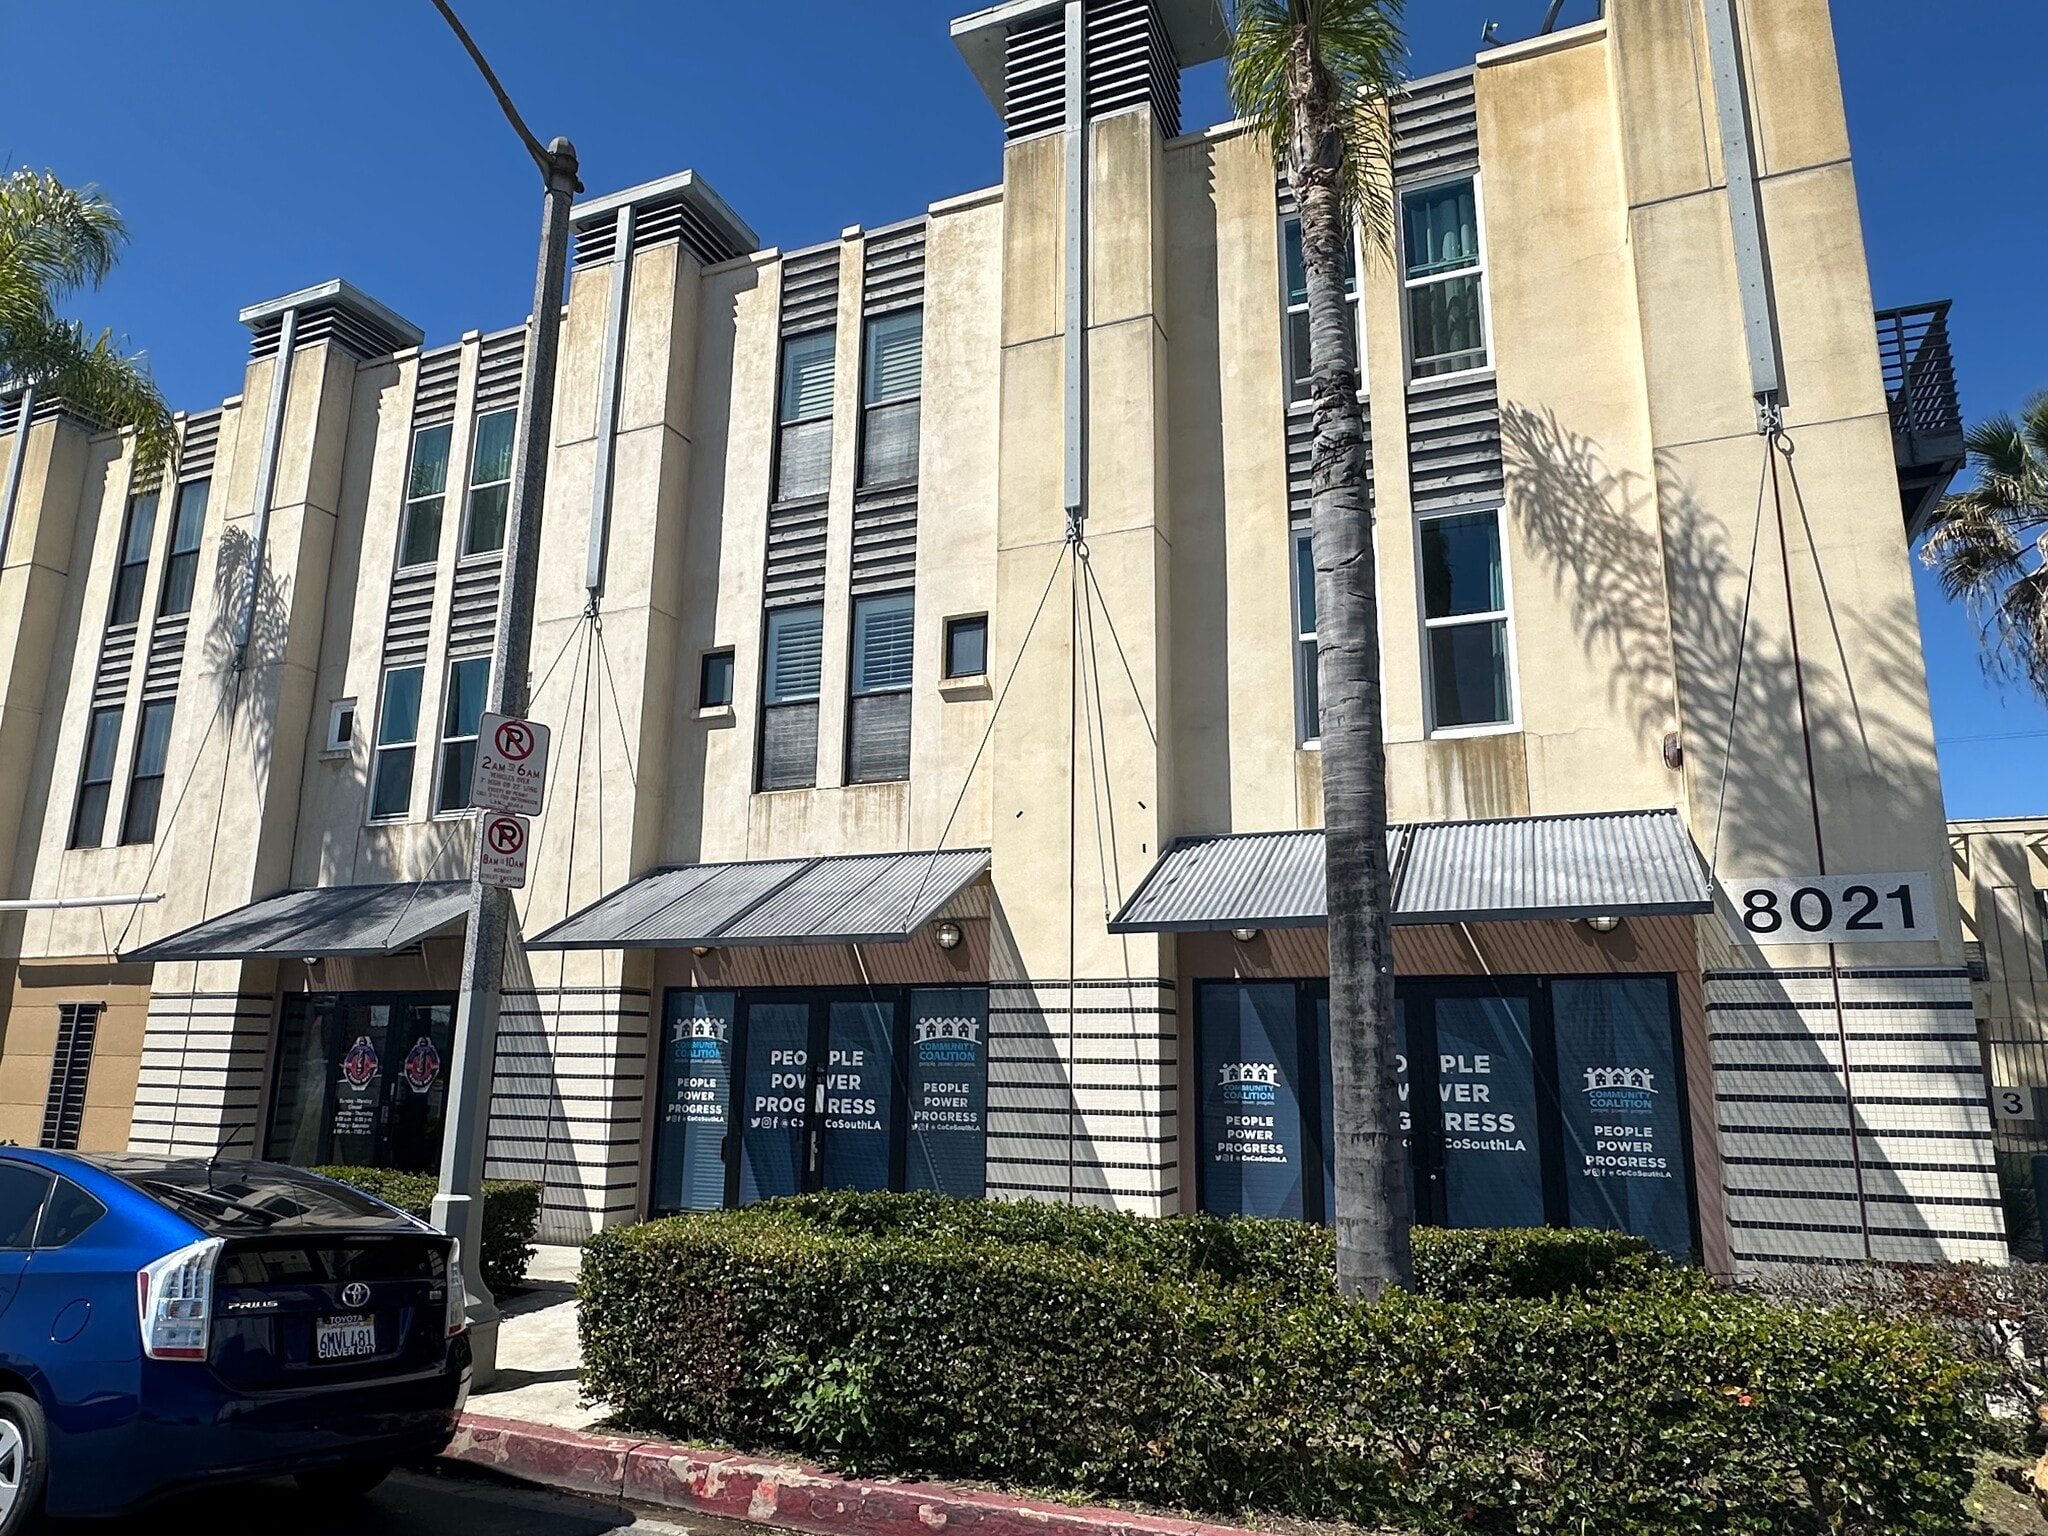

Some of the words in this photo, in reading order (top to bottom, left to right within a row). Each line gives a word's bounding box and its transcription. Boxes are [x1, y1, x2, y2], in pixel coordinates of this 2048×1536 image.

[1743, 884, 1917, 935] 8021
[919, 1051, 976, 1061] COALITION
[677, 1078, 717, 1088] PEOPLE
[923, 1083, 969, 1093] PEOPLE
[677, 1091, 716, 1101] POWER
[1224, 1091, 1275, 1100] COALITION
[1589, 1090, 1652, 1100] COMMUNITY
[924, 1097, 968, 1108] POWER
[1589, 1098, 1653, 1109] COALITION
[2003, 1092, 2024, 1115] 3
[668, 1104, 722, 1115] PROGRESS
[914, 1111, 978, 1122] PROGRESS
[1226, 1115, 1274, 1127] PEOPLE
[1227, 1129, 1273, 1140] POWER
[1594, 1125, 1653, 1138] PEOPLE
[1218, 1142, 1284, 1154] PROGRESS
[1596, 1141, 1653, 1153] POWER
[1585, 1155, 1667, 1169] PROGRESS
[329, 1314, 363, 1324] TOYOTA
[320, 1328, 372, 1352] 6MVL481
[318, 1345, 356, 1359] CULVER
[356, 1343, 376, 1355] CITY
